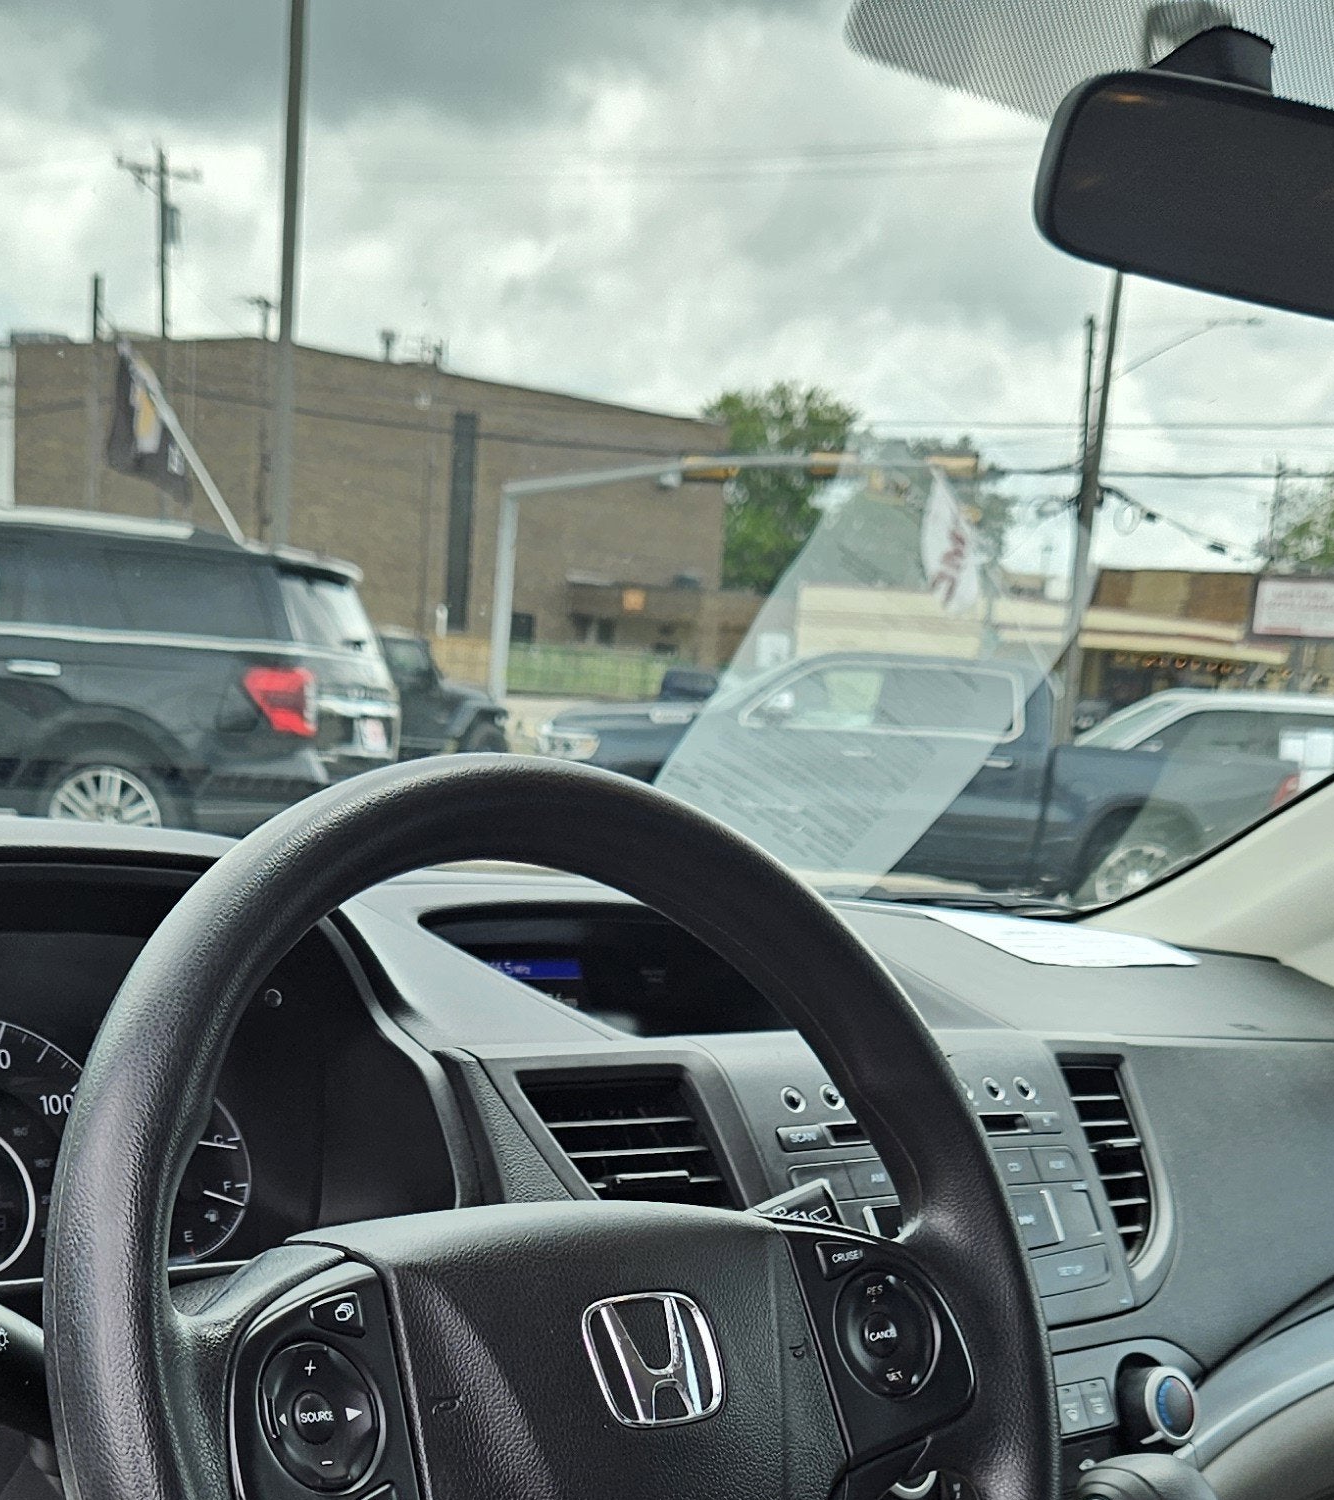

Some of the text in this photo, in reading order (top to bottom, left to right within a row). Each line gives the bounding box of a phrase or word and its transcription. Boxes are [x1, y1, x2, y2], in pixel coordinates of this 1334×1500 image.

[223, 1181, 232, 1192] F
[184, 1230, 195, 1243] E
[831, 1250, 859, 1264] CRUISE
[885, 1370, 904, 1382] SET
[299, 1411, 335, 1424] SOURCE
